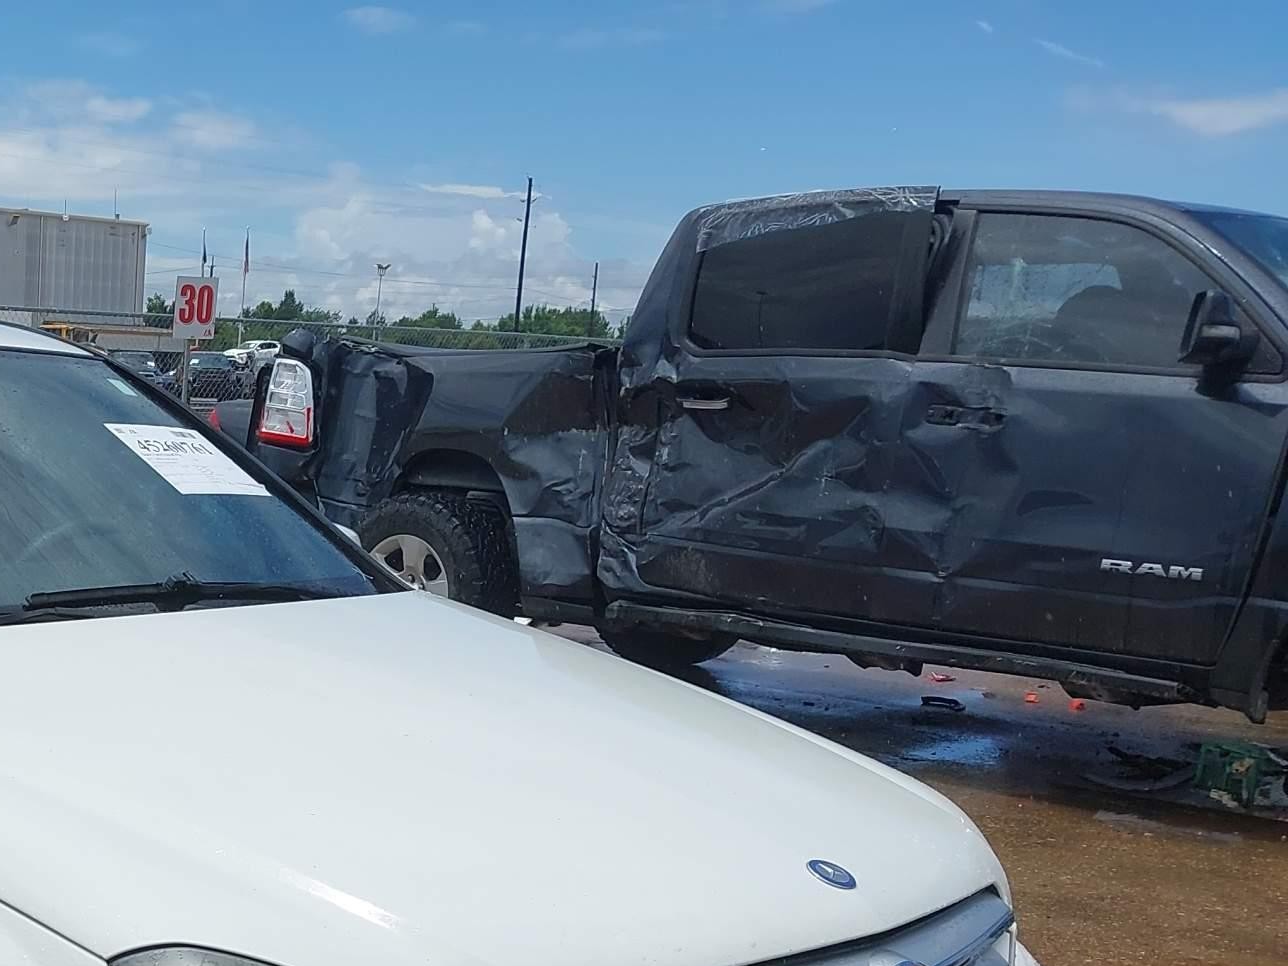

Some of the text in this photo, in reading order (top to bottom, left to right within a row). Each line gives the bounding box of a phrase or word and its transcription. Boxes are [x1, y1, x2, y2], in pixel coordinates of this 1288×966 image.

[178, 284, 213, 325] 30
[136, 439, 214, 455] 45260761
[1100, 558, 1204, 580] RAM
